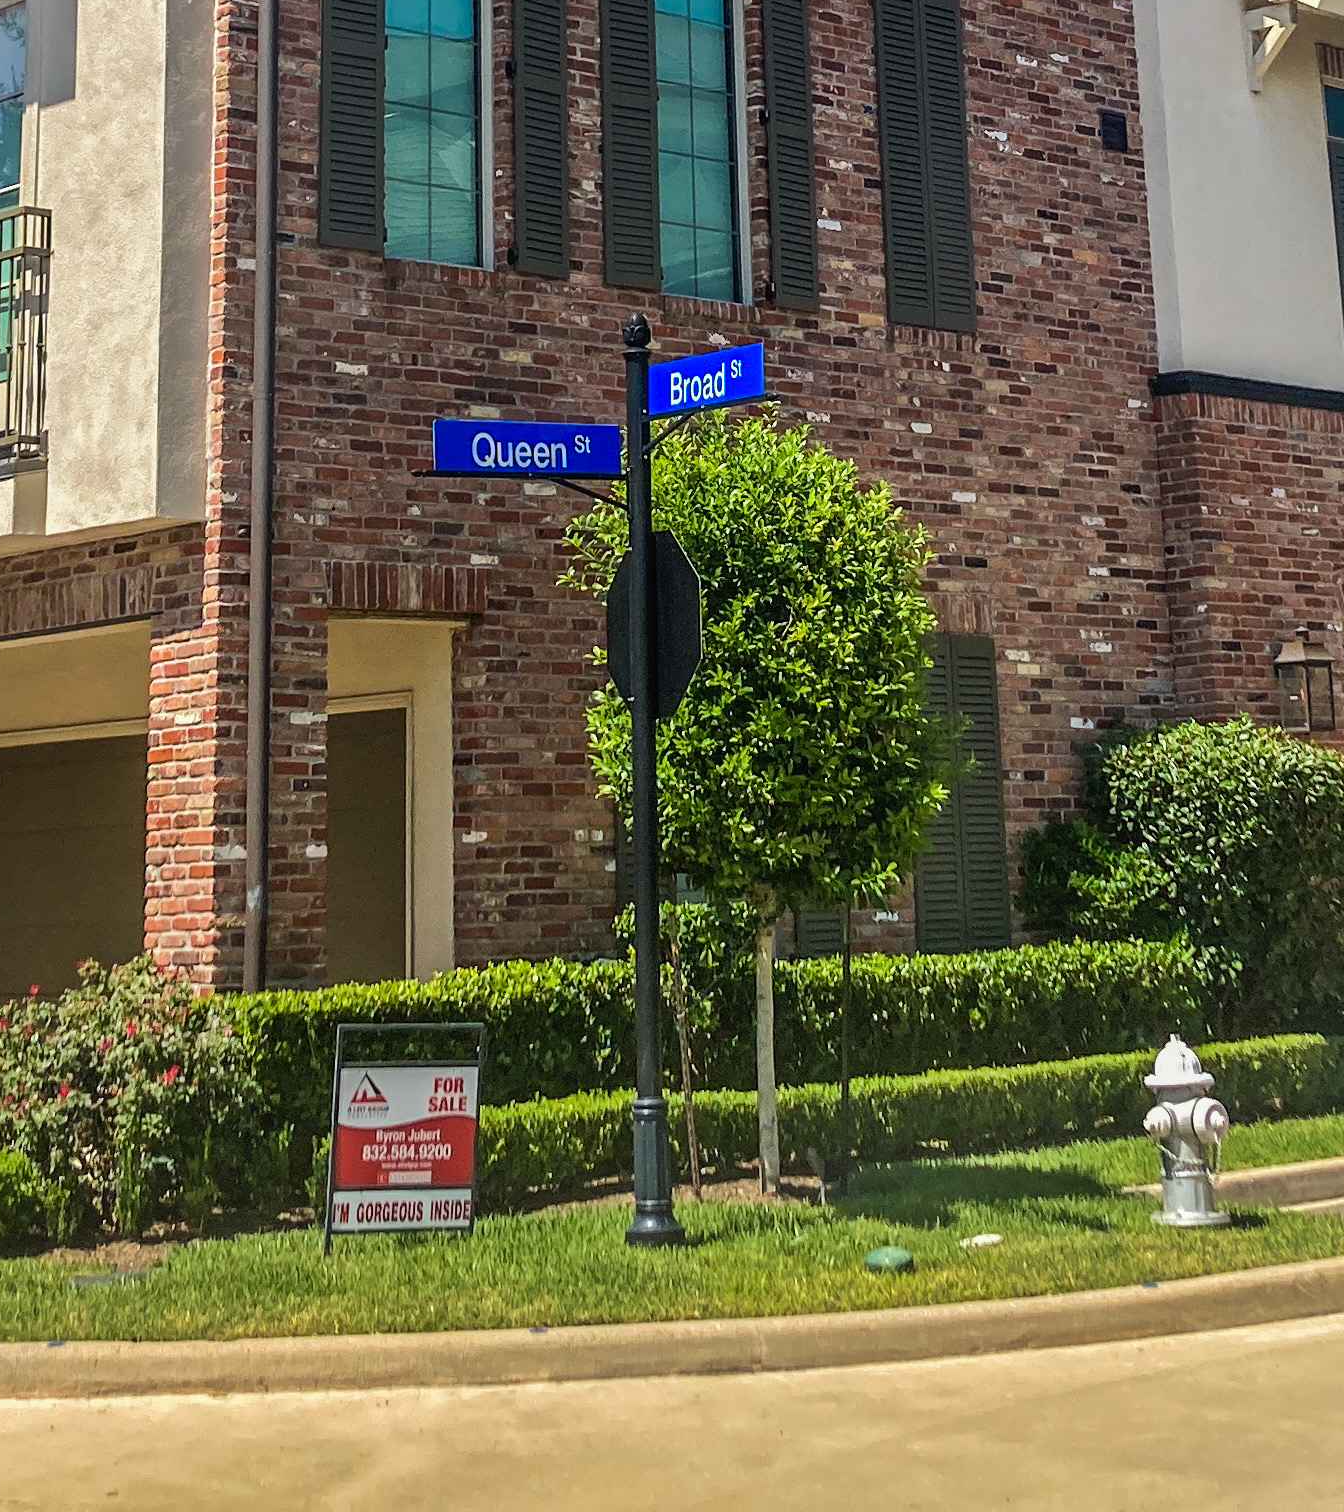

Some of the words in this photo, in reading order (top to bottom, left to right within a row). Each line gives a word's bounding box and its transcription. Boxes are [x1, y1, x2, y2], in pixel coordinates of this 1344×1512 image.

[670, 363, 725, 406] Broad
[730, 358, 742, 379] St
[471, 432, 567, 469] Queen
[574, 434, 591, 454] St
[434, 1077, 464, 1093] FOR
[428, 1096, 467, 1112] SALE
[376, 1130, 406, 1144] Byron
[332, 1203, 350, 1223] I'M
[357, 1201, 423, 1223] GORGEOUS
[430, 1199, 470, 1221] INSIDE
